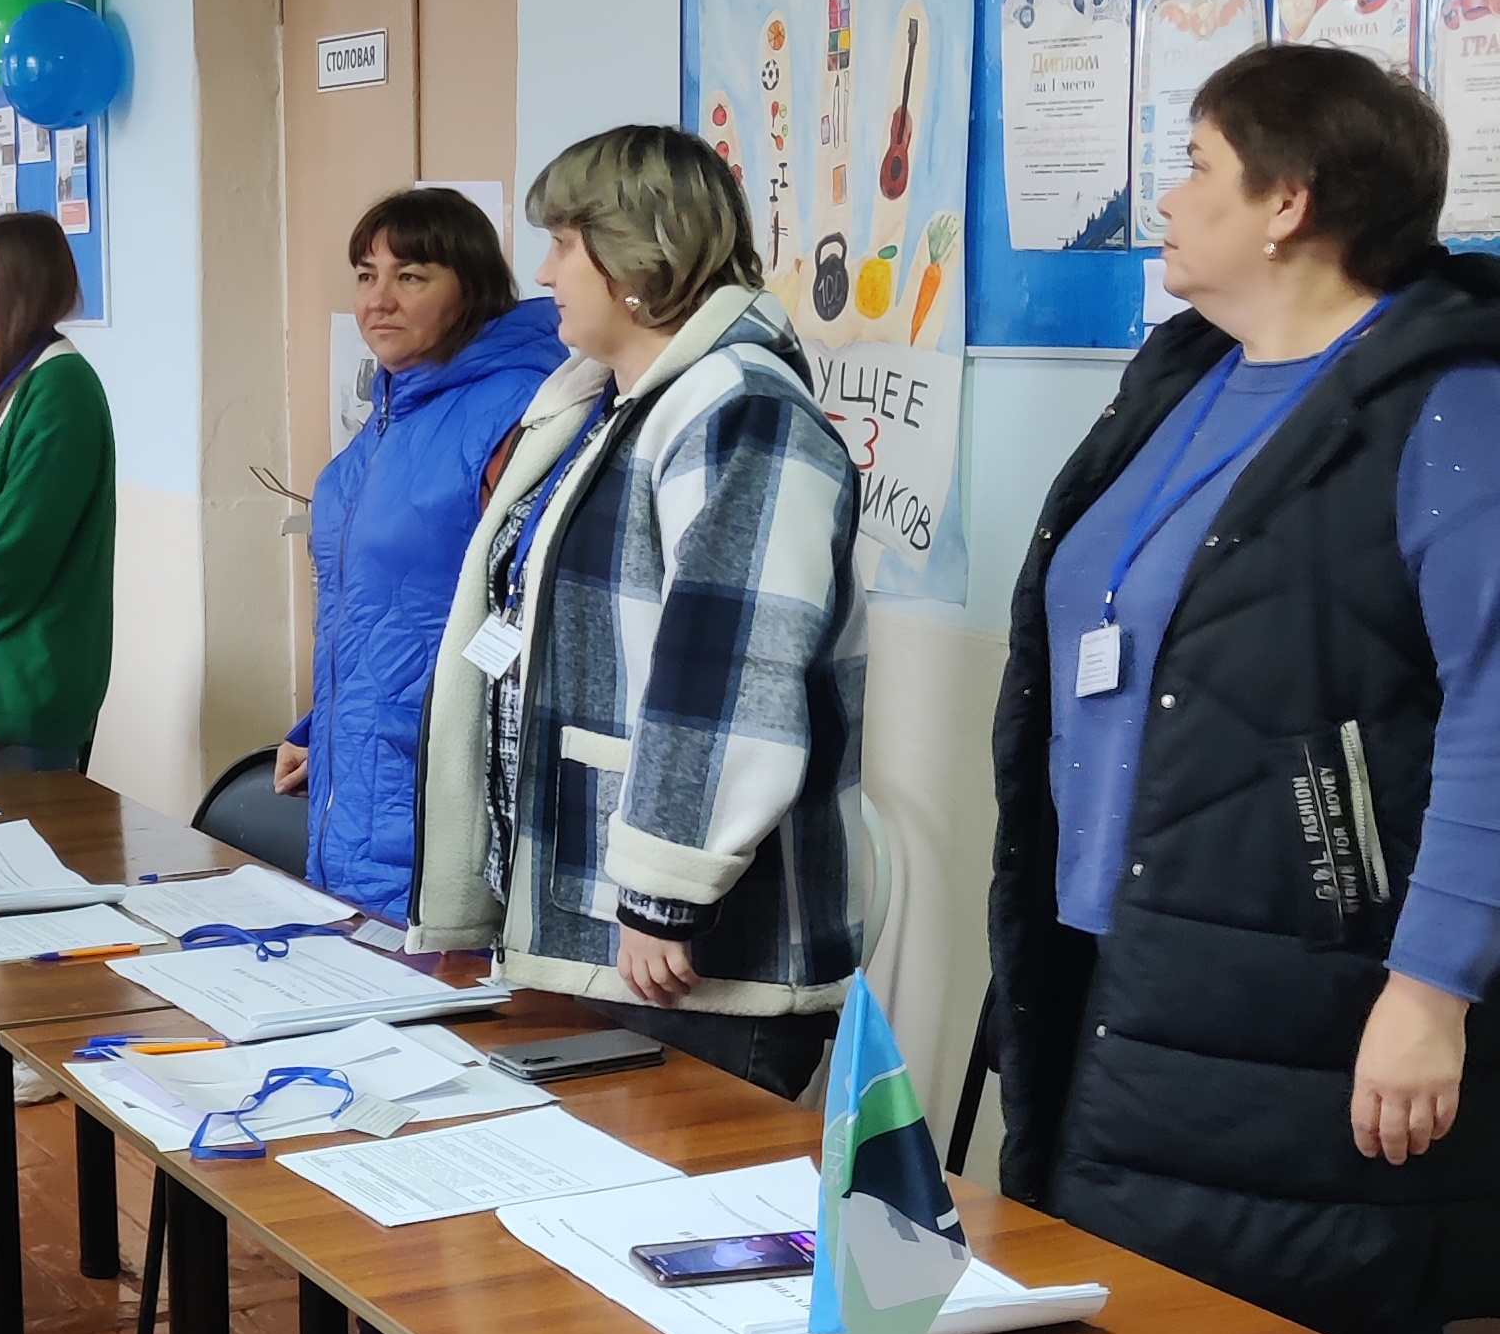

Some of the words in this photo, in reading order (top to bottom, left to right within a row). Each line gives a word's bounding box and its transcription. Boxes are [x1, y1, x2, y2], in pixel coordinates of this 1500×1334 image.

[1319, 21, 1380, 40] ГРАМОТА
[326, 45, 376, 72] СТОЛОВАЯ
[1031, 52, 1100, 78] Диплом
[1034, 83, 1046, 93] за
[1061, 80, 1095, 92] место
[817, 269, 844, 308] 100
[1292, 776, 1323, 843] FASHION
